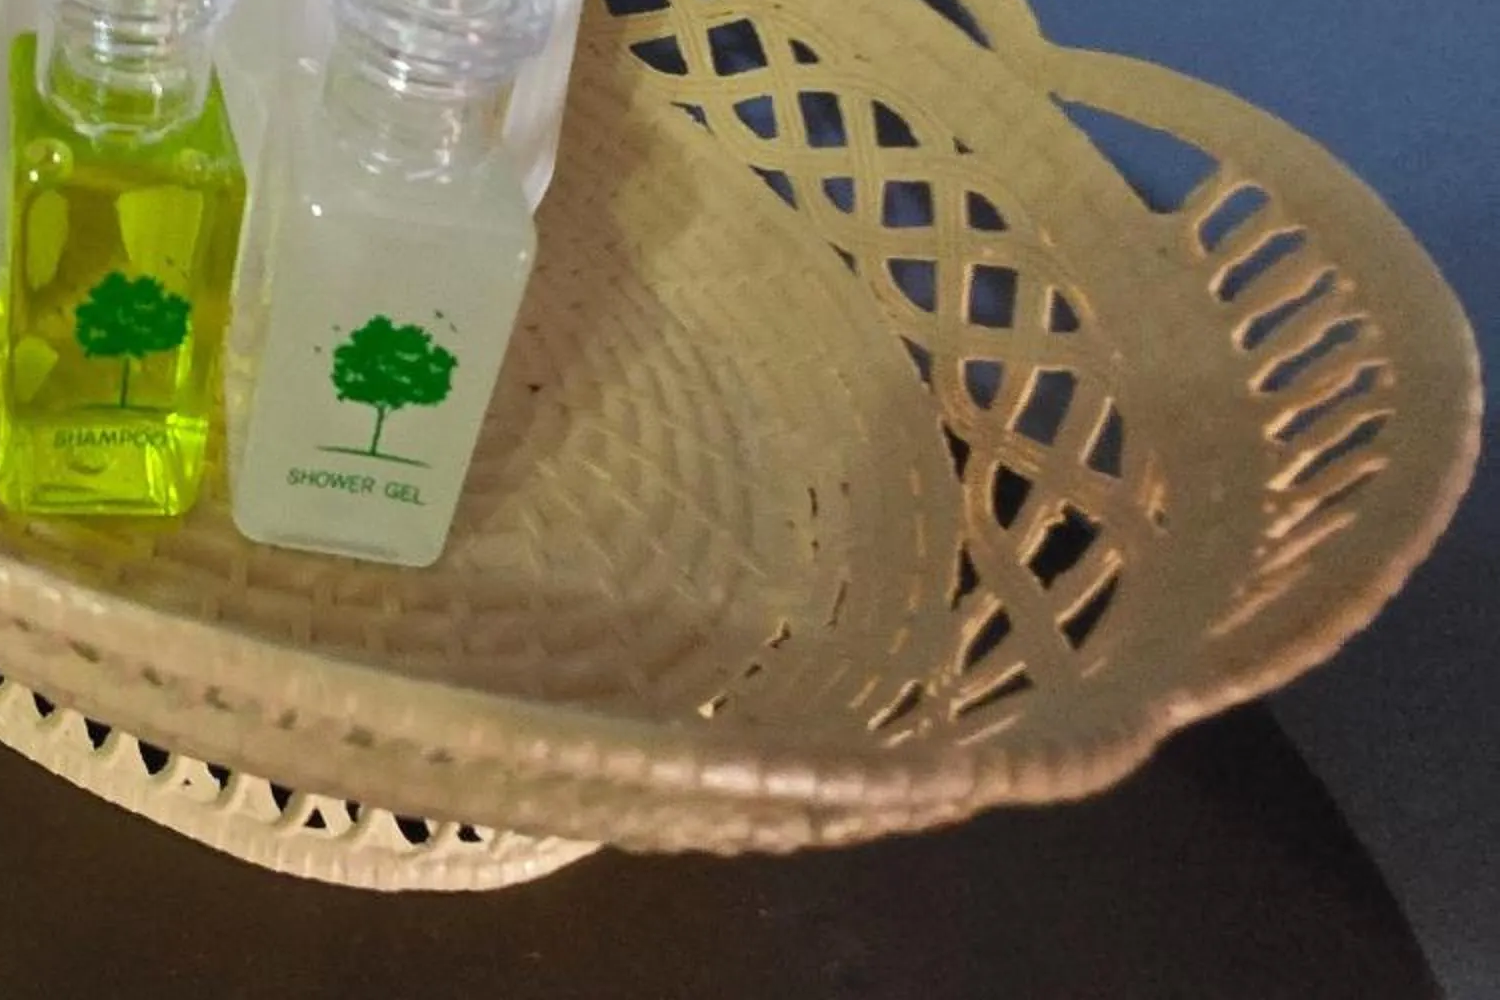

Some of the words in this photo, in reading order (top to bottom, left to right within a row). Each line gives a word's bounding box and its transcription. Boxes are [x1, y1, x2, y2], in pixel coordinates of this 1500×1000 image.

[53, 427, 168, 449] SHAMPOO
[286, 467, 376, 495] SHOWER
[384, 481, 426, 506] GEL
